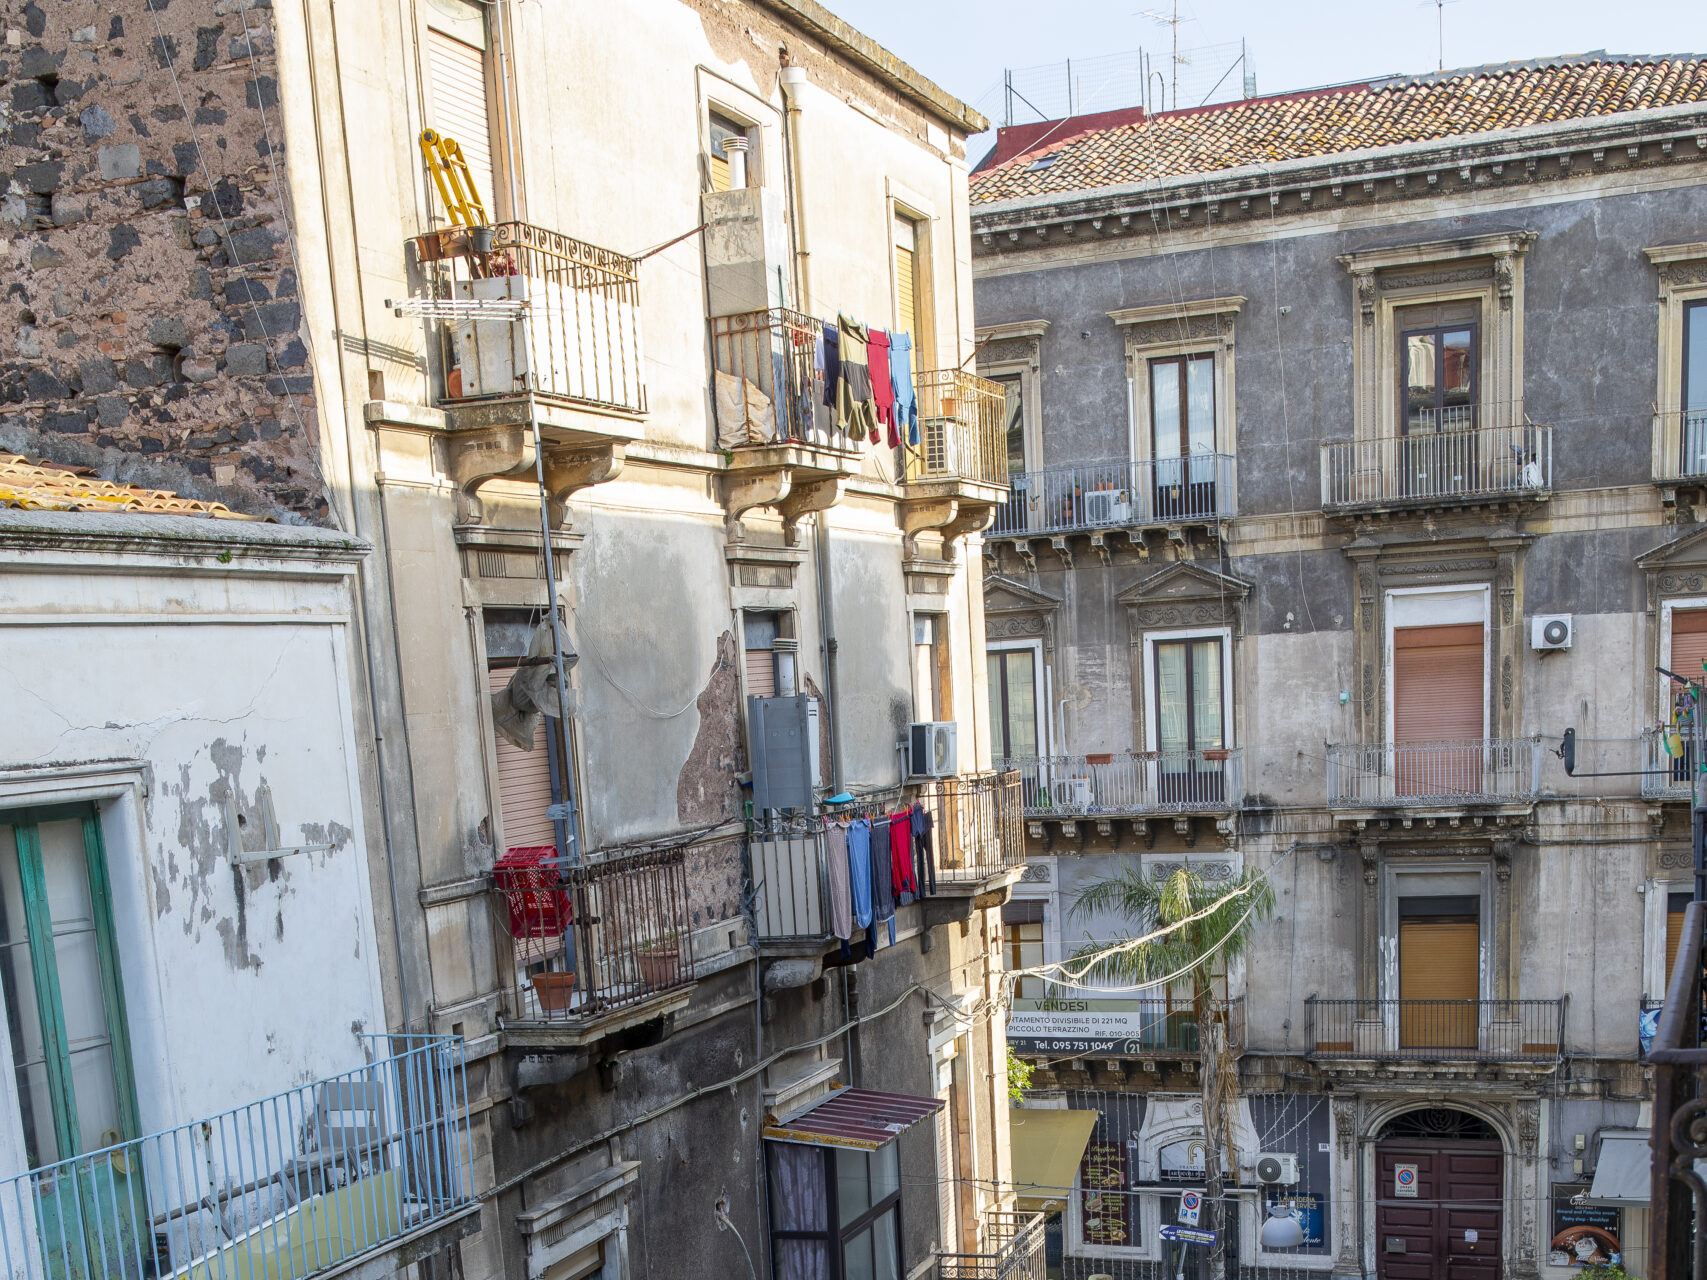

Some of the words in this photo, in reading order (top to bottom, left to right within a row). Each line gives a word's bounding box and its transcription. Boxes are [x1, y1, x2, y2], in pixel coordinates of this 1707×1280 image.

[1035, 1001, 1088, 1011] VENDESI
[1052, 1017, 1090, 1025] DIVISIBILE
[1101, 1017, 1113, 1025] 221
[1115, 1017, 1128, 1025] MQ
[1008, 1025, 1042, 1033] PICCOLO
[1043, 1025, 1089, 1033] TERRAZZINO
[1034, 1040, 1051, 1049] Tel.
[1052, 1041, 1071, 1050] 095
[1073, 1041, 1089, 1050] 751
[1090, 1041, 1114, 1050] 1049
